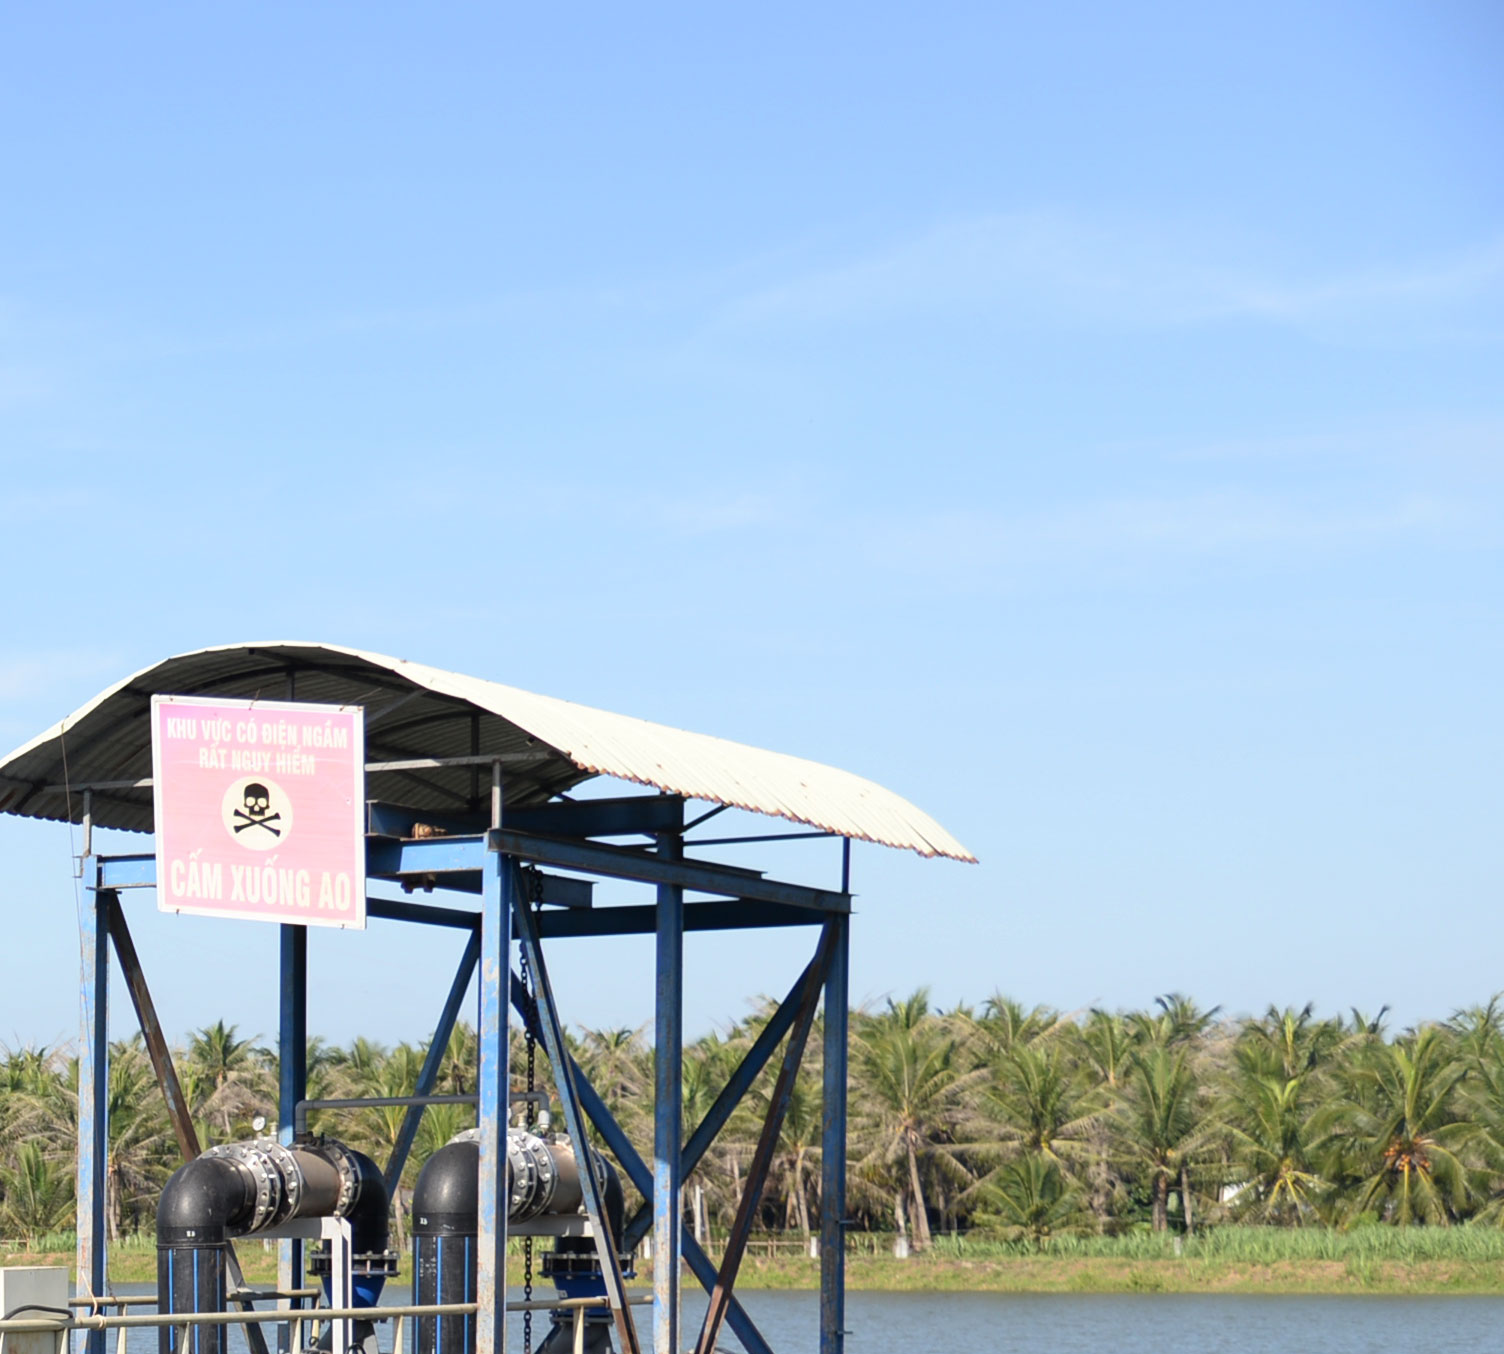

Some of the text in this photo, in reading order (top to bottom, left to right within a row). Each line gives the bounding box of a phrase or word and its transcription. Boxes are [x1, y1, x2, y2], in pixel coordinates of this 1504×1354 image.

[167, 717, 196, 739] KHU
[201, 716, 232, 744] VỰC
[236, 718, 257, 744] CÓ
[261, 720, 297, 750] ĐIỆN
[199, 742, 227, 769] RẤT
[232, 749, 272, 772] NGUY
[170, 848, 350, 911] CẤM XUỐNG AO
